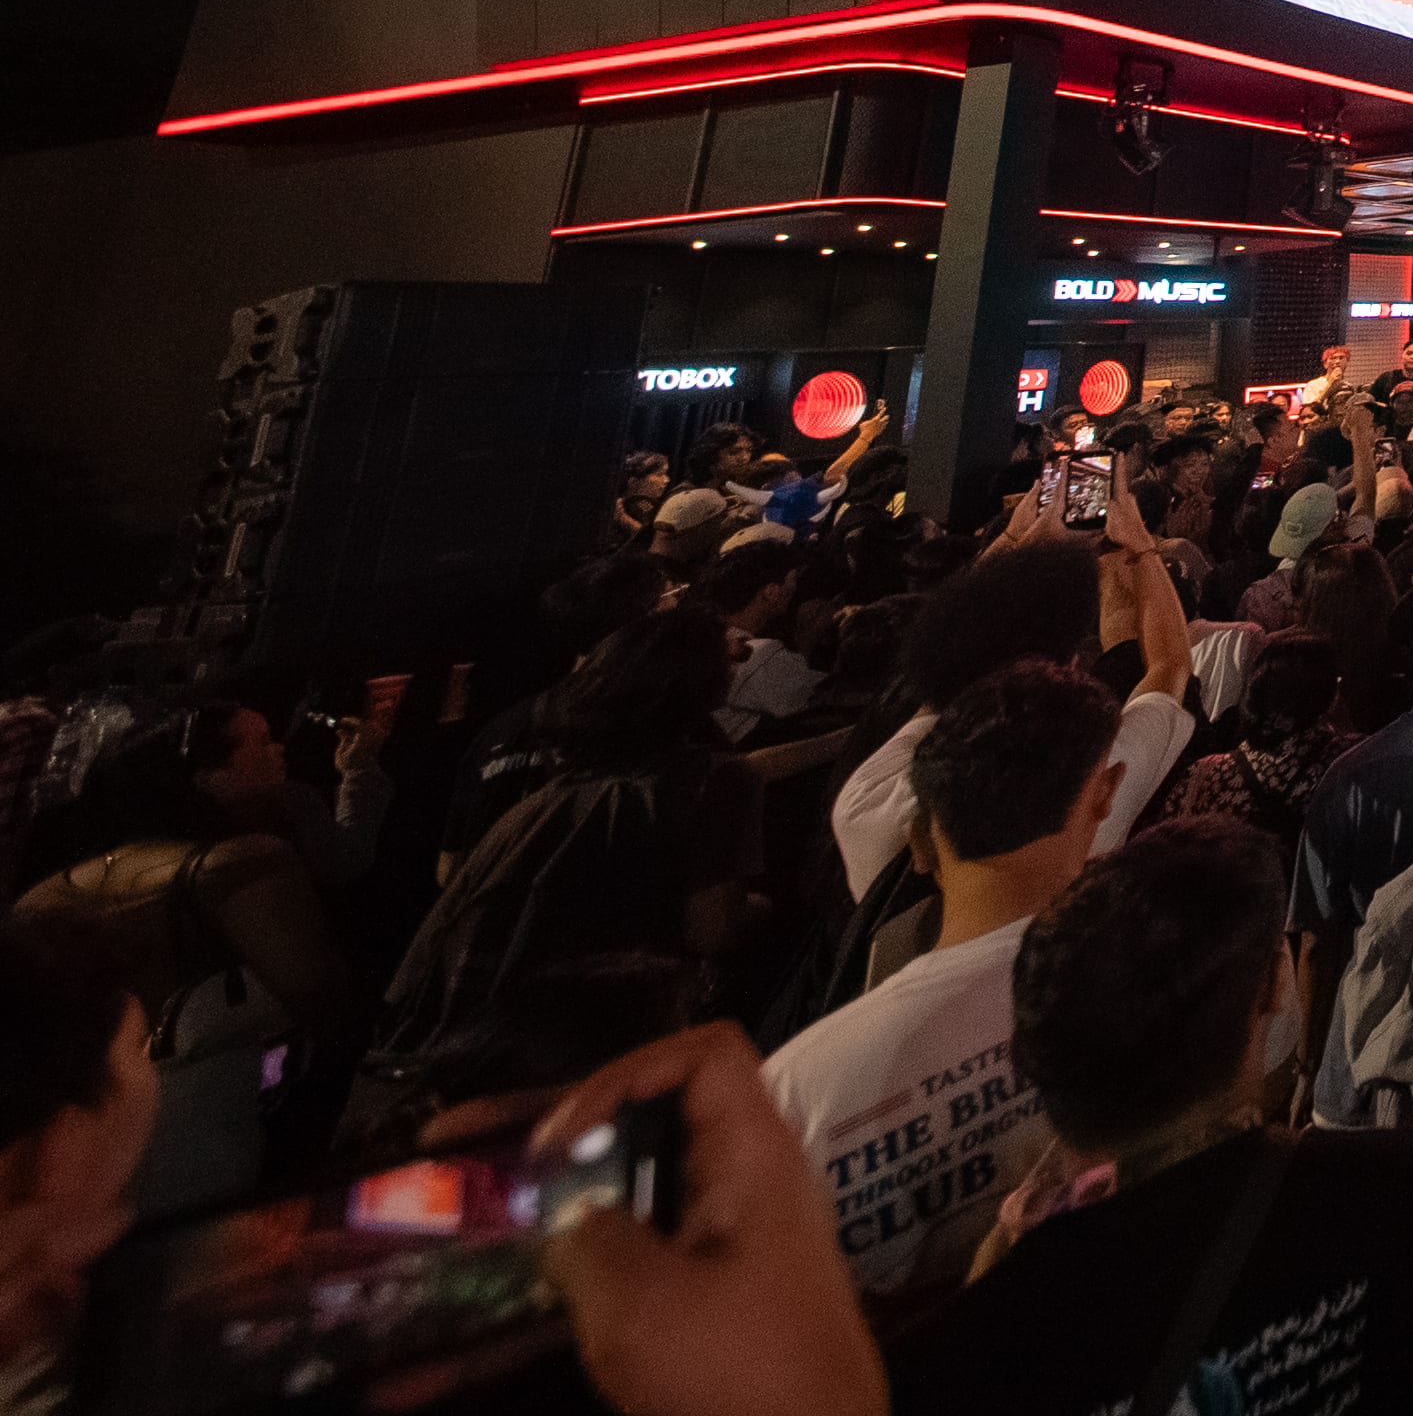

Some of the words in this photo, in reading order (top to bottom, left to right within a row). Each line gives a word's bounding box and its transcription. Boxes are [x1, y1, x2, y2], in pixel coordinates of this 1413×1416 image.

[1053, 278, 1115, 303] BOLD
[1136, 277, 1228, 305] MUSIC
[826, 1113, 934, 1190] THE
[839, 1153, 997, 1255] CLUB
